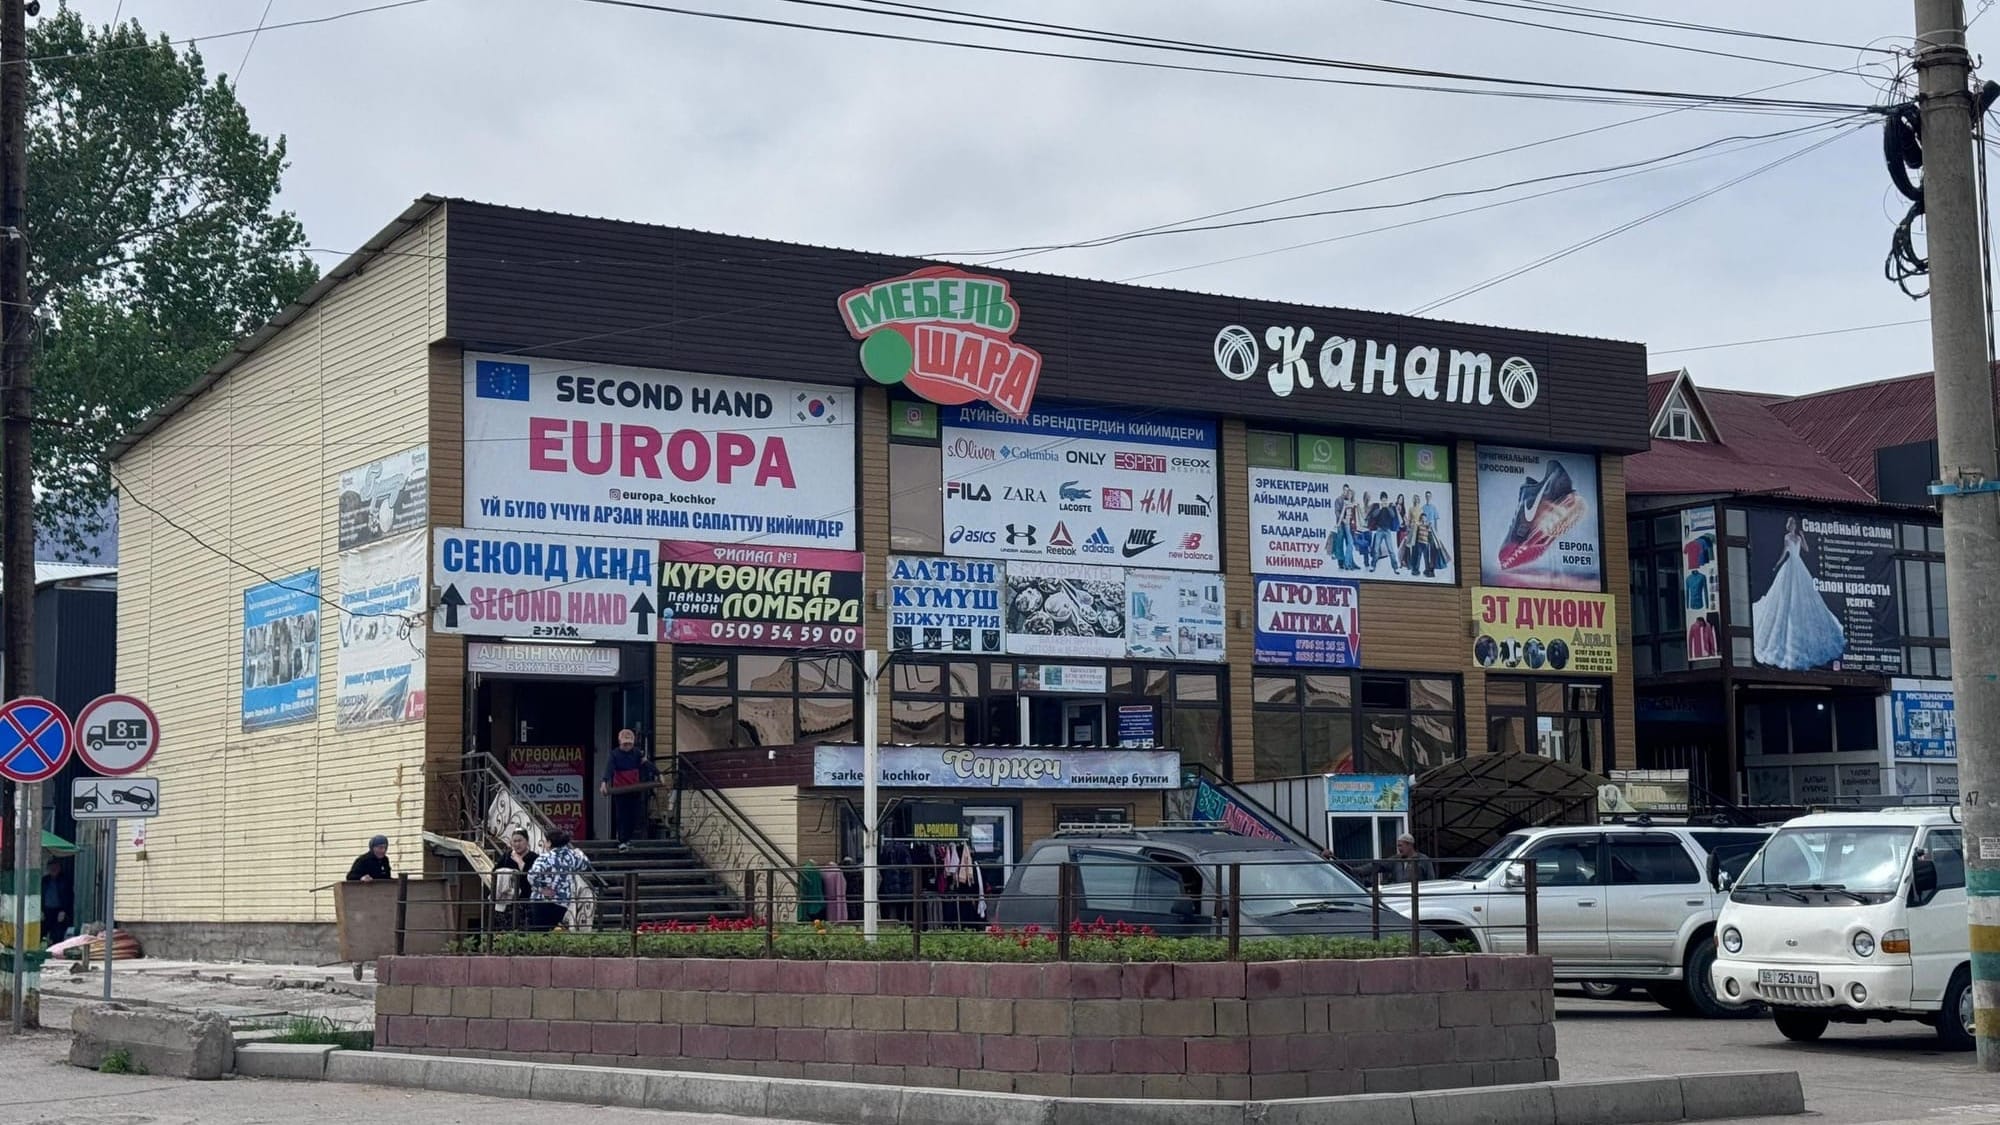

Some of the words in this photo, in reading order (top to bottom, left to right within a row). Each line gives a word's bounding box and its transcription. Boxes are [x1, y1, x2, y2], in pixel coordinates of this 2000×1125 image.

[849, 280, 1014, 330] МЕБЕЛЬ
[917, 327, 1035, 415] ШАРА
[1265, 326, 1494, 406] Канат
[556, 375, 683, 411] SECOND
[692, 388, 773, 419] HAND
[1032, 414, 1125, 435] БРЕНДТЕРДИН
[1128, 421, 1204, 442] КИЙИМДЕРИ
[529, 416, 797, 489] EUROPA
[1011, 446, 1060, 463] Columbia
[1065, 450, 1107, 466] ONLY
[1479, 451, 1540, 464] ОРИГИНАЛЬНЫЕ
[1114, 452, 1167, 473] ESPRIT
[1171, 457, 1211, 468] GEOX
[1478, 463, 1525, 475] КРОССОВКИ
[947, 482, 992, 502] FILA
[1255, 477, 1329, 494] ЭРКЕКТЕРДИН
[622, 490, 717, 507] europa_kochkor
[1002, 486, 1047, 503] ZARA
[1139, 488, 1174, 518] H&M
[1253, 491, 1332, 509] АЙЫМДАРДЫН
[1059, 503, 1092, 513] LACOSTE
[1277, 509, 1309, 523] ЖАНА
[480, 496, 501, 518] ҮЙ
[505, 501, 546, 521] БҮЛӨ
[551, 502, 591, 523] ҮЧҮН
[593, 506, 643, 526] АРЗАН
[646, 509, 689, 528] ЖАНА
[692, 512, 764, 533] САПАТТУУ
[766, 515, 844, 539] КИЙИМДЕР
[965, 529, 997, 544] asics
[1128, 528, 1158, 546] NIKE
[1260, 524, 1327, 540] БАЛДАРДЫН
[1802, 518, 1862, 537] Свадебный
[1862, 526, 1893, 540] салон
[1046, 545, 1077, 556] Reebok
[1082, 543, 1115, 555] adidas
[1268, 539, 1321, 554] САПАТТУУ
[1559, 541, 1594, 553] ЕВРОПА
[443, 538, 568, 583] СЕКОНД
[575, 544, 651, 587] ХЕНД
[713, 548, 774, 564] ФИЛИАЛ
[778, 550, 799, 564] №1
[1168, 551, 1183, 560] new
[1185, 551, 1214, 561] balance
[1265, 555, 1324, 570] КИЙИМДЕР
[1562, 554, 1592, 566] КОРЕЯ
[662, 561, 832, 596] КҮРӨӨКАНА
[892, 559, 996, 584] АЛТЫН
[1021, 562, 1112, 581] СУХОФРУКТЫ
[1262, 580, 1312, 607] АГРО
[1316, 585, 1353, 608] ВЕТ
[1812, 578, 1844, 593] Салон
[1845, 581, 1891, 596] красоты
[470, 586, 565, 623] SECOND
[567, 590, 627, 625] HAND
[668, 591, 724, 605] ПАЙЫЗЫ
[892, 586, 999, 610] КҮМҮШ
[674, 603, 718, 615] ТӨМӨН
[722, 592, 860, 624] ЛОМБАРД
[1481, 595, 1509, 624] ЭТ
[1515, 598, 1605, 630] ДҮКӨНҮ
[892, 612, 1001, 629] БИЖУТЕРИЯ
[1269, 610, 1346, 635] АПТЕКА
[711, 622, 763, 640] 0509
[771, 626, 793, 641] 54
[800, 627, 822, 643] 59
[829, 628, 857, 644] 00
[1570, 628, 1613, 648] Адал
[479, 646, 544, 662] АЛТЫН
[549, 647, 612, 663] КҮМҮШ
[505, 662, 584, 673] БИЖУТЕРИЯ
[510, 748, 582, 763] КҮРӨӨКАНА
[882, 770, 931, 782] kochkor
[942, 749, 1062, 786] Саркеч
[556, 783, 570, 794] 60
[1071, 773, 1129, 787] кийимдер
[1132, 773, 1169, 785] бутиги
[1198, 782, 1227, 820] ВЕТ
[1965, 791, 1979, 806] 47
[522, 803, 582, 818] ОМБАРД
[1778, 973, 1796, 984] 251
